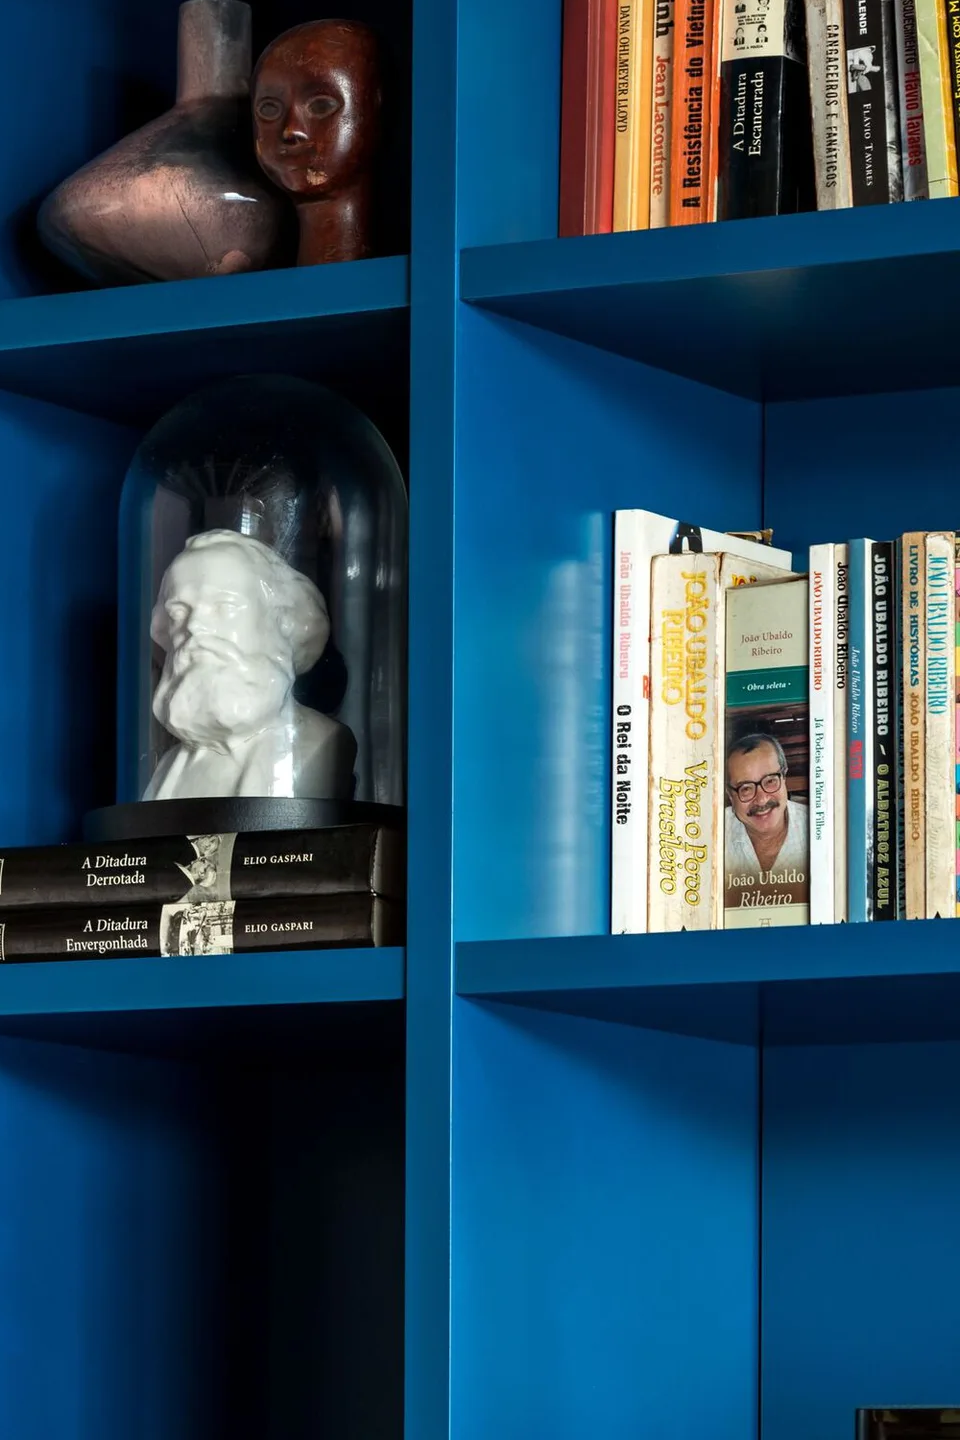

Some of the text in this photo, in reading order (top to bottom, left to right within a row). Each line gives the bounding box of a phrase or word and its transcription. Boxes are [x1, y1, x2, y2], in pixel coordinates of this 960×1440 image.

[616, 5, 631, 133] DANA OHLMEYER LLOYD
[685, 56, 704, 78] do
[825, 24, 840, 188] CANGACEIROS E FANÁTICOS
[652, 55, 672, 197] Jean Lacouture
[682, 85, 704, 189] Resistência
[732, 72, 747, 151] A Ditadura
[748, 71, 764, 157] Escancarada
[682, 196, 701, 209] A
[863, 142, 874, 187] TAVARES
[619, 551, 632, 679] João Ubaldo Ribeiro
[740, 630, 793, 648] João Ubaldo
[751, 646, 783, 657] Ribeiro
[813, 570, 824, 691] JOÃO UBALDO RIBEIRO
[874, 554, 889, 736] JOÃO UBALDO RIBEIRO
[909, 545, 921, 687] LIVRO DE HISTÓRIAS
[927, 553, 952, 716] JOÃO UBALDO RIBEIRO
[681, 571, 710, 741] JOÃO UBALDO
[746, 681, 787, 692] Obra seleta
[851, 646, 861, 667] João
[851, 670, 861, 701] Ubaldo
[851, 702, 861, 734] Ribeiro
[616, 705, 632, 825] O Rei da Noite
[814, 717, 825, 841] Já Podeis da Pátria Filhos
[910, 692, 921, 841] JOÃO UBALDO RIBEIRO
[81, 853, 147, 869] A Ditadura
[243, 853, 314, 866] ELIO GASPARI
[658, 776, 685, 896] Brasileiro
[683, 760, 709, 907] Viva o Povo
[877, 763, 890, 909] O ALBATROZ AZUL
[86, 870, 146, 887] Derrotada
[727, 868, 805, 889] João Ubaldo
[739, 889, 793, 909] Ribeiro
[66, 934, 149, 954] Envergonhada
[83, 917, 149, 933] A Ditadura
[244, 921, 314, 934] ELIO GASPARI
